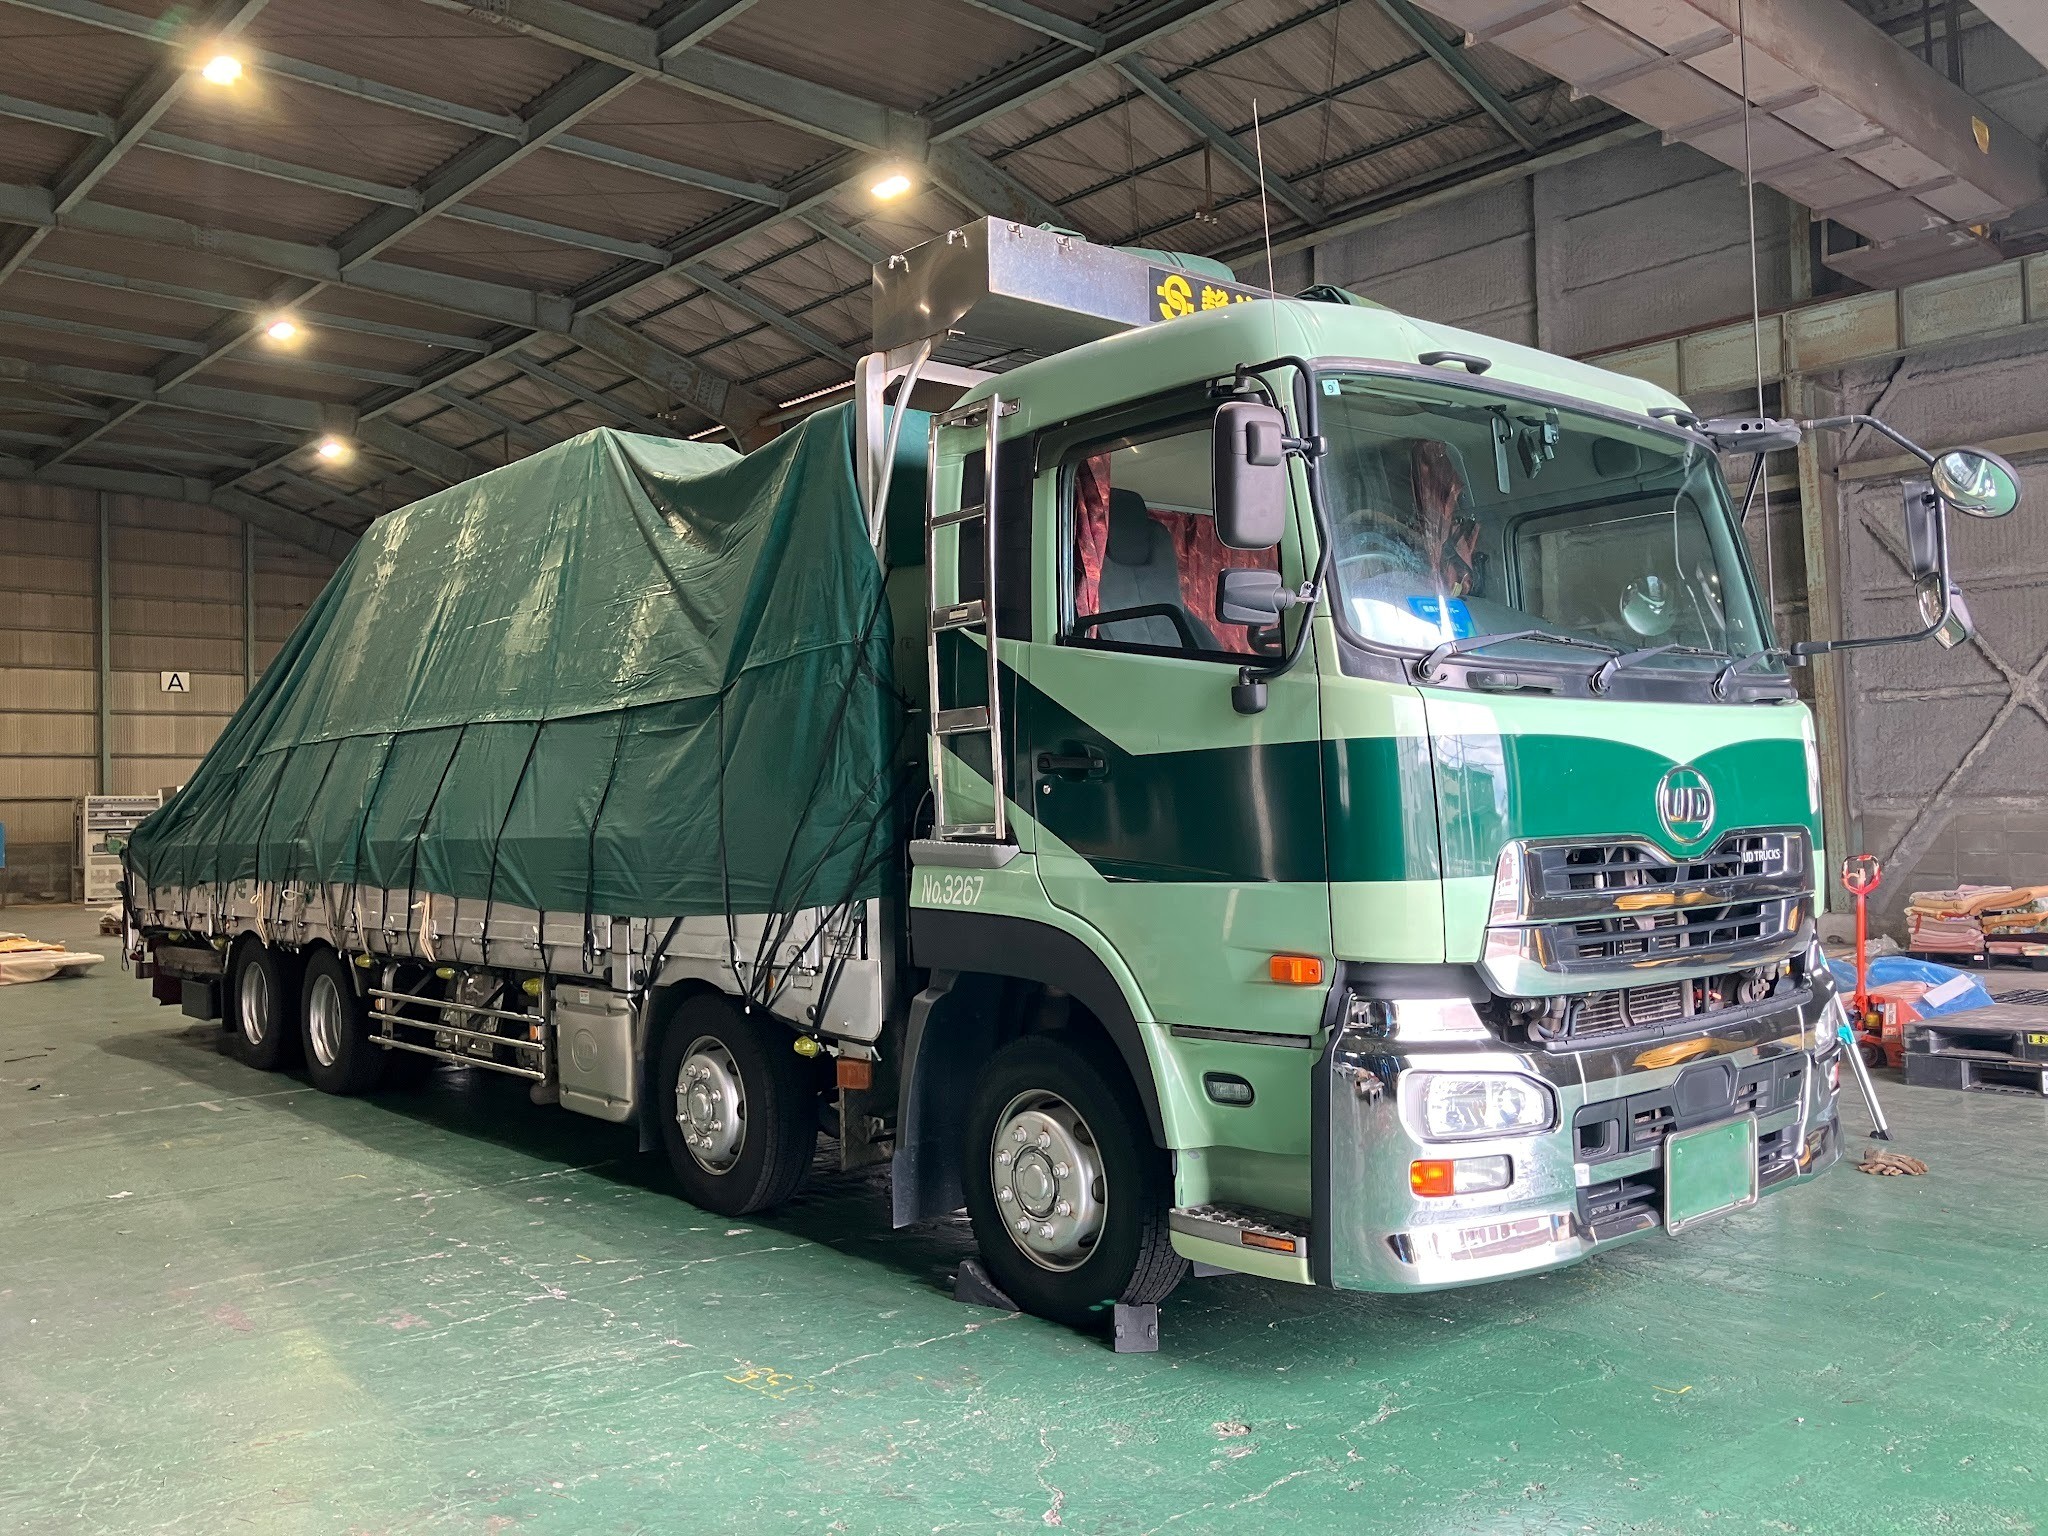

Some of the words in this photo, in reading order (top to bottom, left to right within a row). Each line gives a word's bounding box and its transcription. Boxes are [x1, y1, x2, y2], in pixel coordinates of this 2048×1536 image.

[1328, 384, 1334, 394] 9
[168, 673, 184, 691] A
[1664, 788, 1710, 822] UD
[1743, 851, 1754, 863] UD
[1754, 849, 1780, 862] TRUCKS
[921, 874, 984, 906] No.3267
